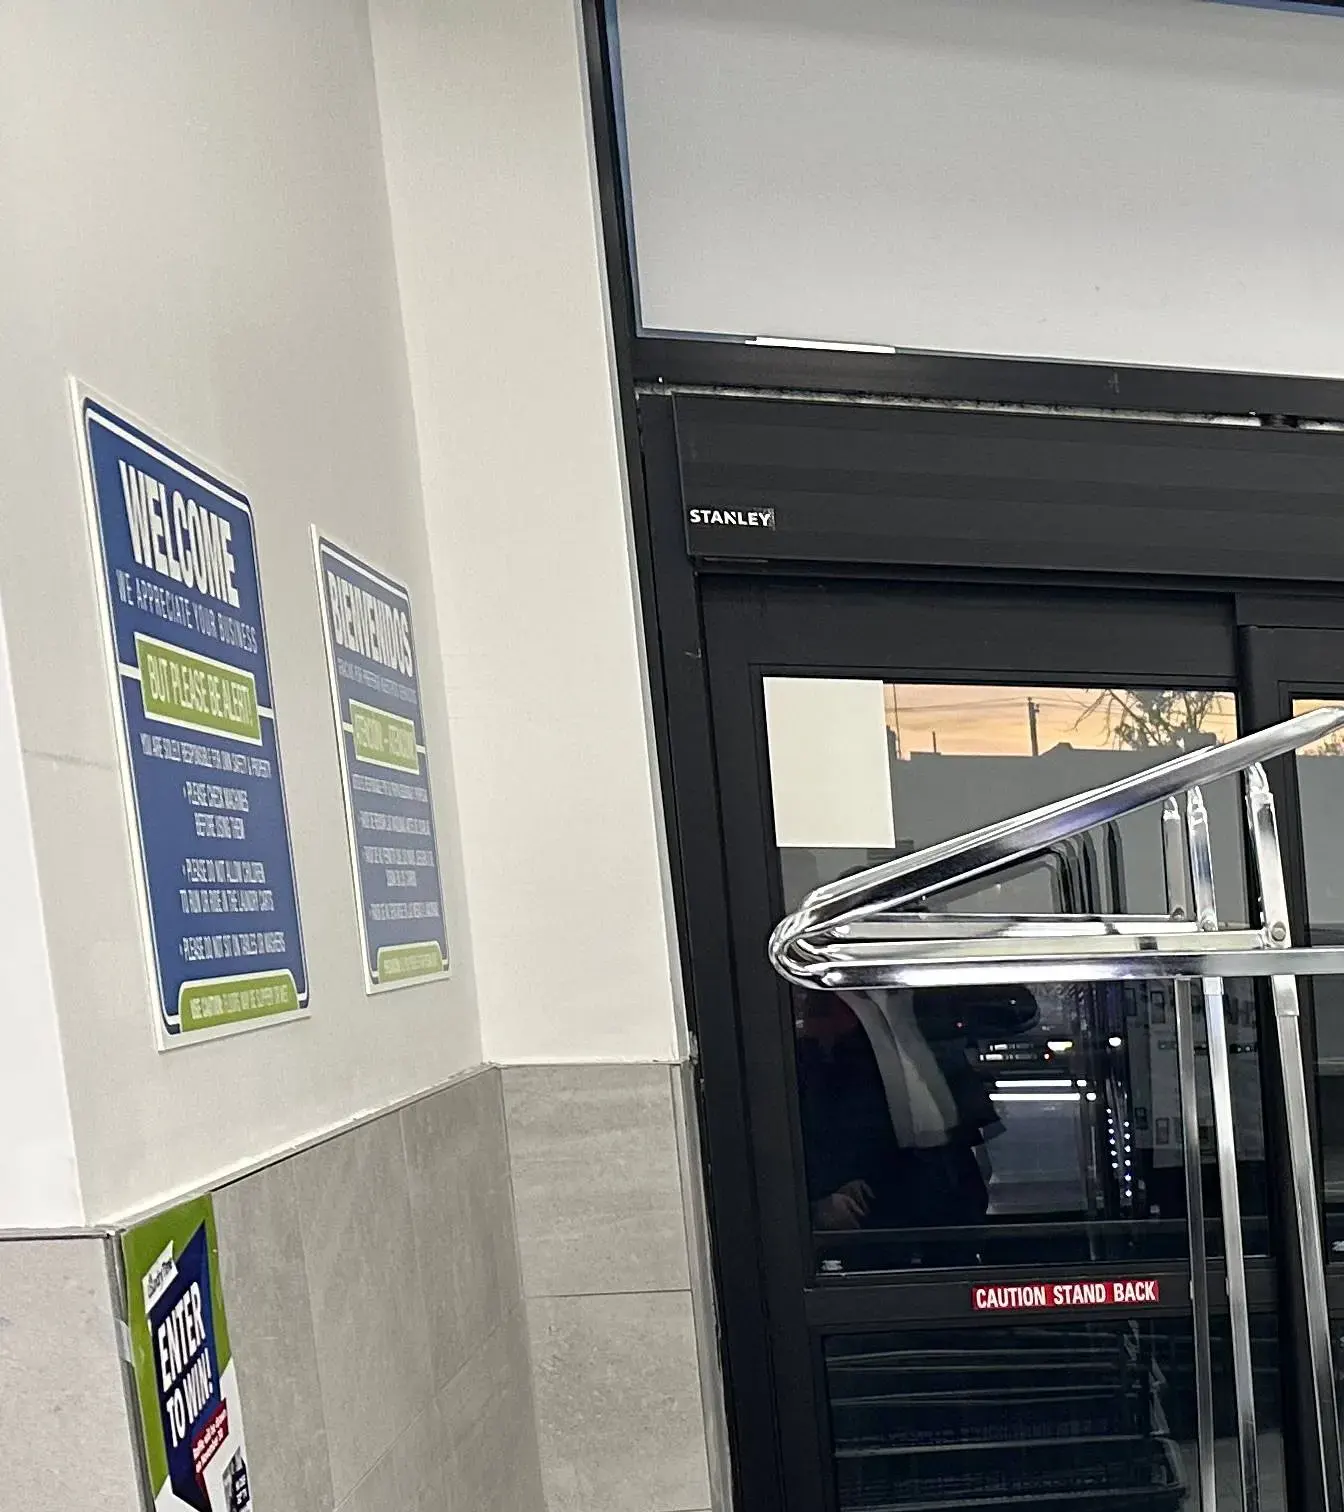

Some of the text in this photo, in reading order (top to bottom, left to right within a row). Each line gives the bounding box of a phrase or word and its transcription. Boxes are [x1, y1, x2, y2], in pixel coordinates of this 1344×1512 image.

[118, 458, 240, 609] WELCOME
[689, 508, 771, 527] STANLEY
[115, 569, 258, 654] WE APPRECIATE YOUR BUSINESS
[327, 570, 413, 678] BIENVENIDOS
[145, 654, 253, 726] BUT PLEASE BE ALERT!
[158, 1281, 206, 1393] ENTER
[976, 1280, 1156, 1309] CAUTION STAND BACK
[167, 1388, 186, 1448] TO
[183, 1347, 213, 1424] WIN!
